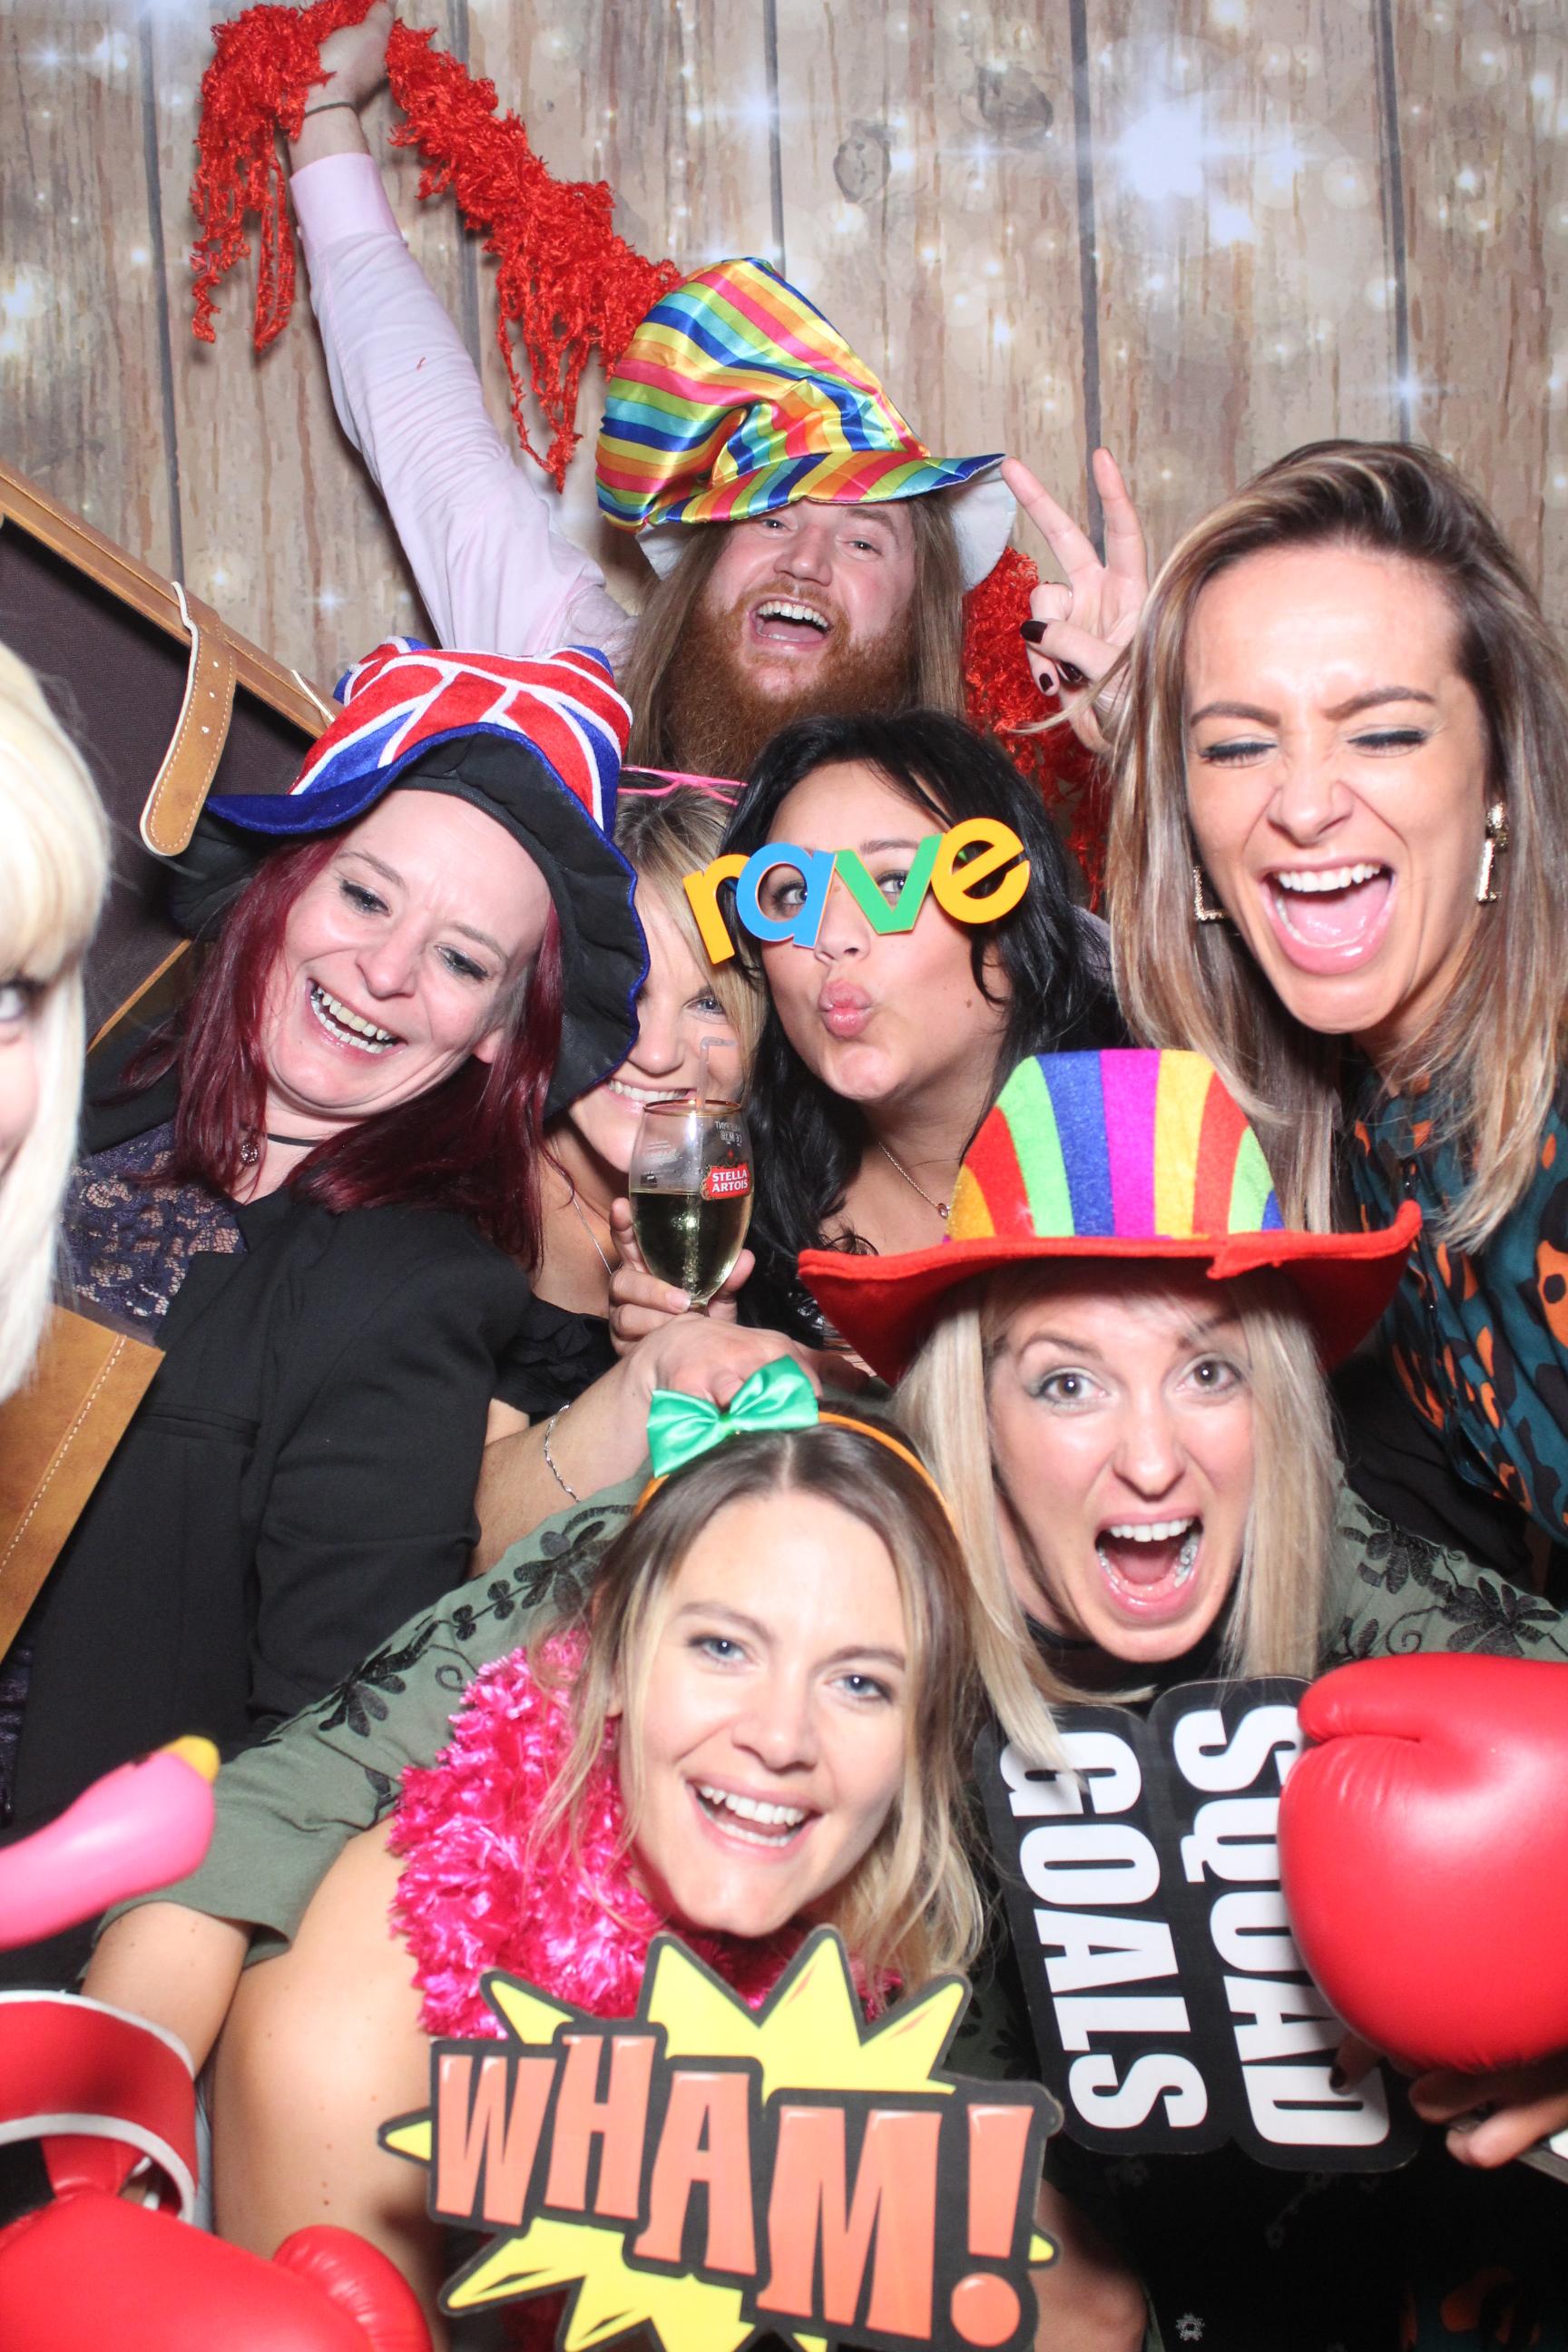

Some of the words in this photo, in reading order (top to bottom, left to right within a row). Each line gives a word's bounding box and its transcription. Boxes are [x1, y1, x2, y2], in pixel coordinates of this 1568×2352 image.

[682, 818, 1031, 965] rave
[711, 1180, 749, 1193] ARTOIS
[712, 1169, 748, 1182] STELLA
[999, 1730, 1209, 2130] GOALS
[1173, 1704, 1390, 2147] SQUAD
[436, 2034, 1034, 2347] WHAM!
